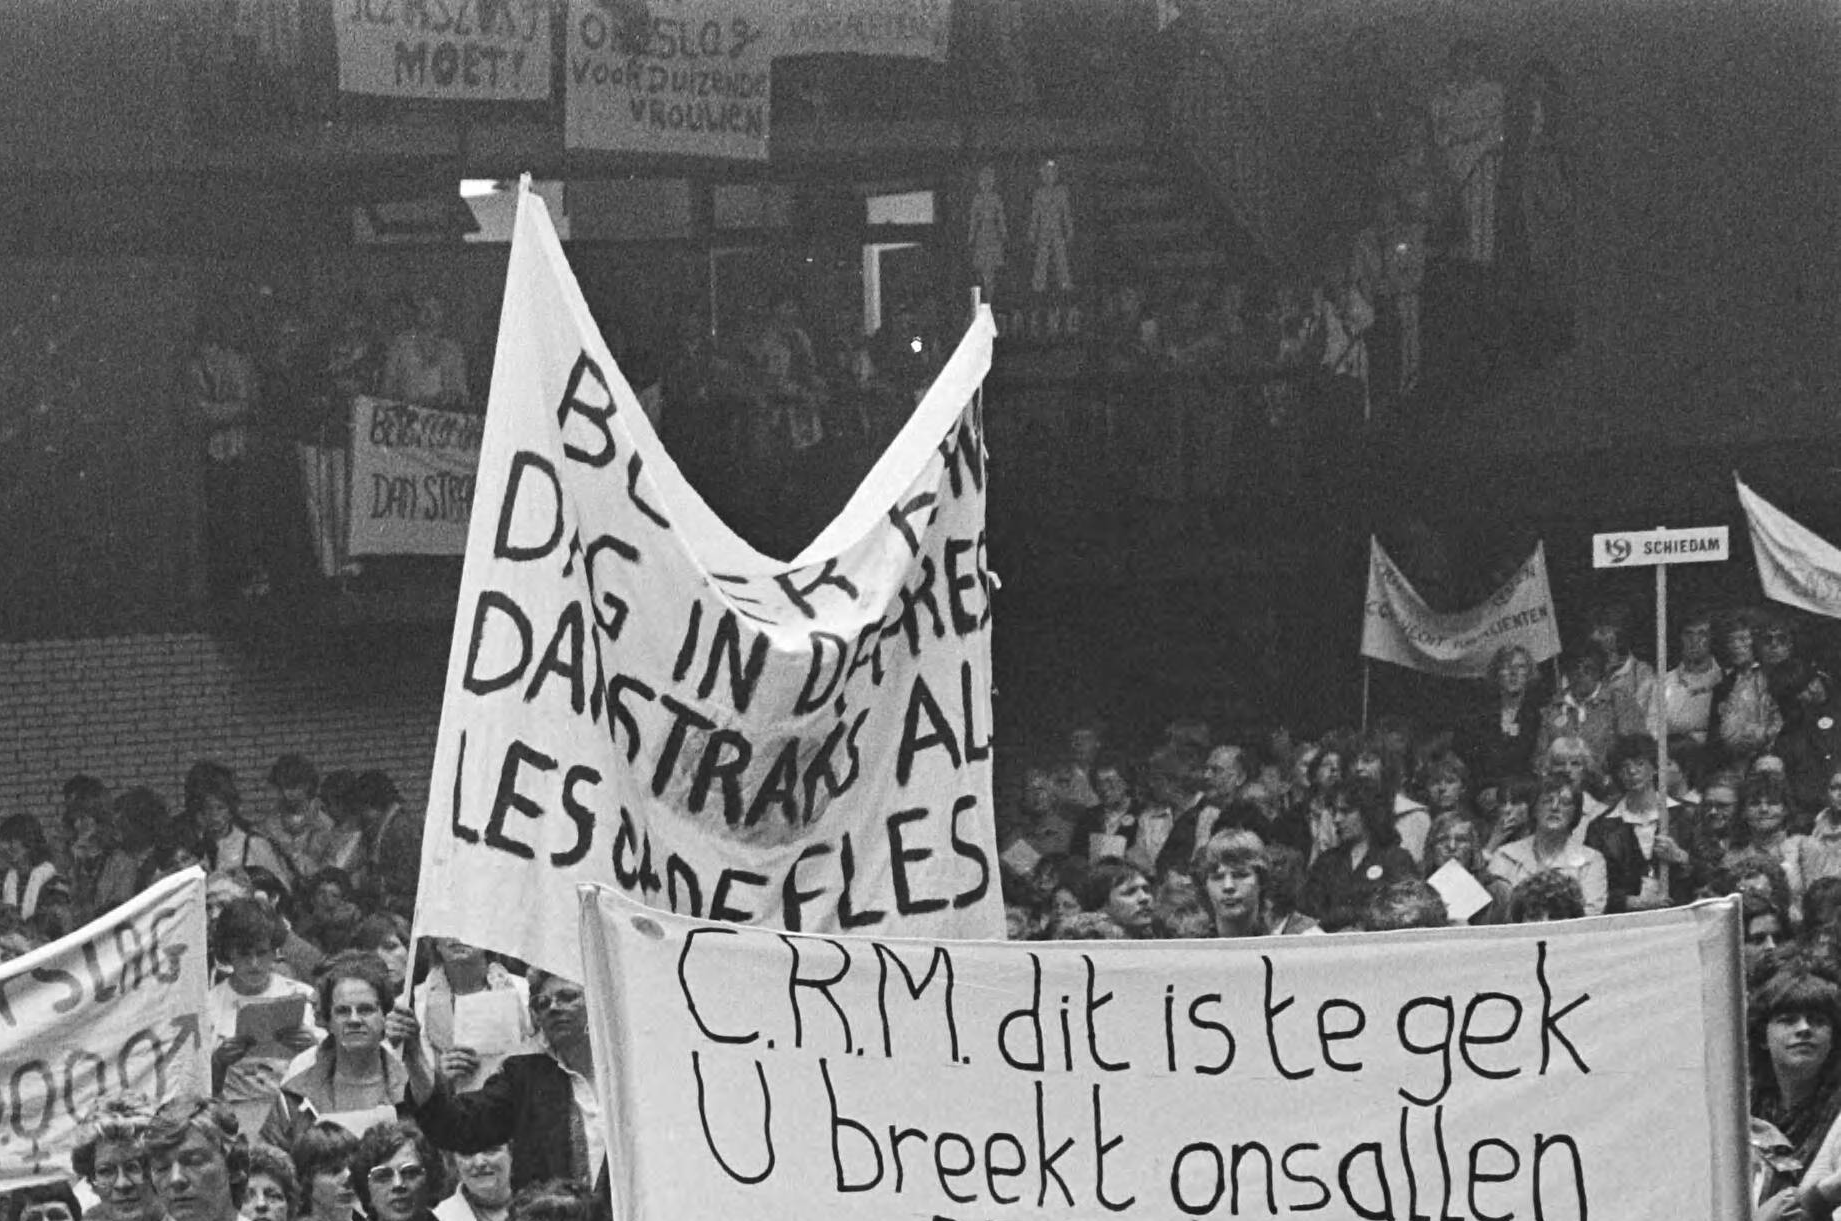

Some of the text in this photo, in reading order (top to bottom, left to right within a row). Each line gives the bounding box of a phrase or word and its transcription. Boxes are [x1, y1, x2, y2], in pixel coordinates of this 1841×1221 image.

[394, 40, 526, 90] MOET!
[423, 471, 477, 522] STRA
[1643, 537, 1720, 556] SCHIEDAM
[672, 598, 770, 715] IN
[452, 730, 602, 867] LES
[782, 794, 990, 932] FLES
[676, 927, 972, 1066] C.R.M.
[999, 953, 1130, 1075] dit
[1164, 982, 1236, 1075] is
[1396, 941, 1592, 1107] gek
[691, 1050, 776, 1186] U
[820, 1058, 1138, 1213] breekt
